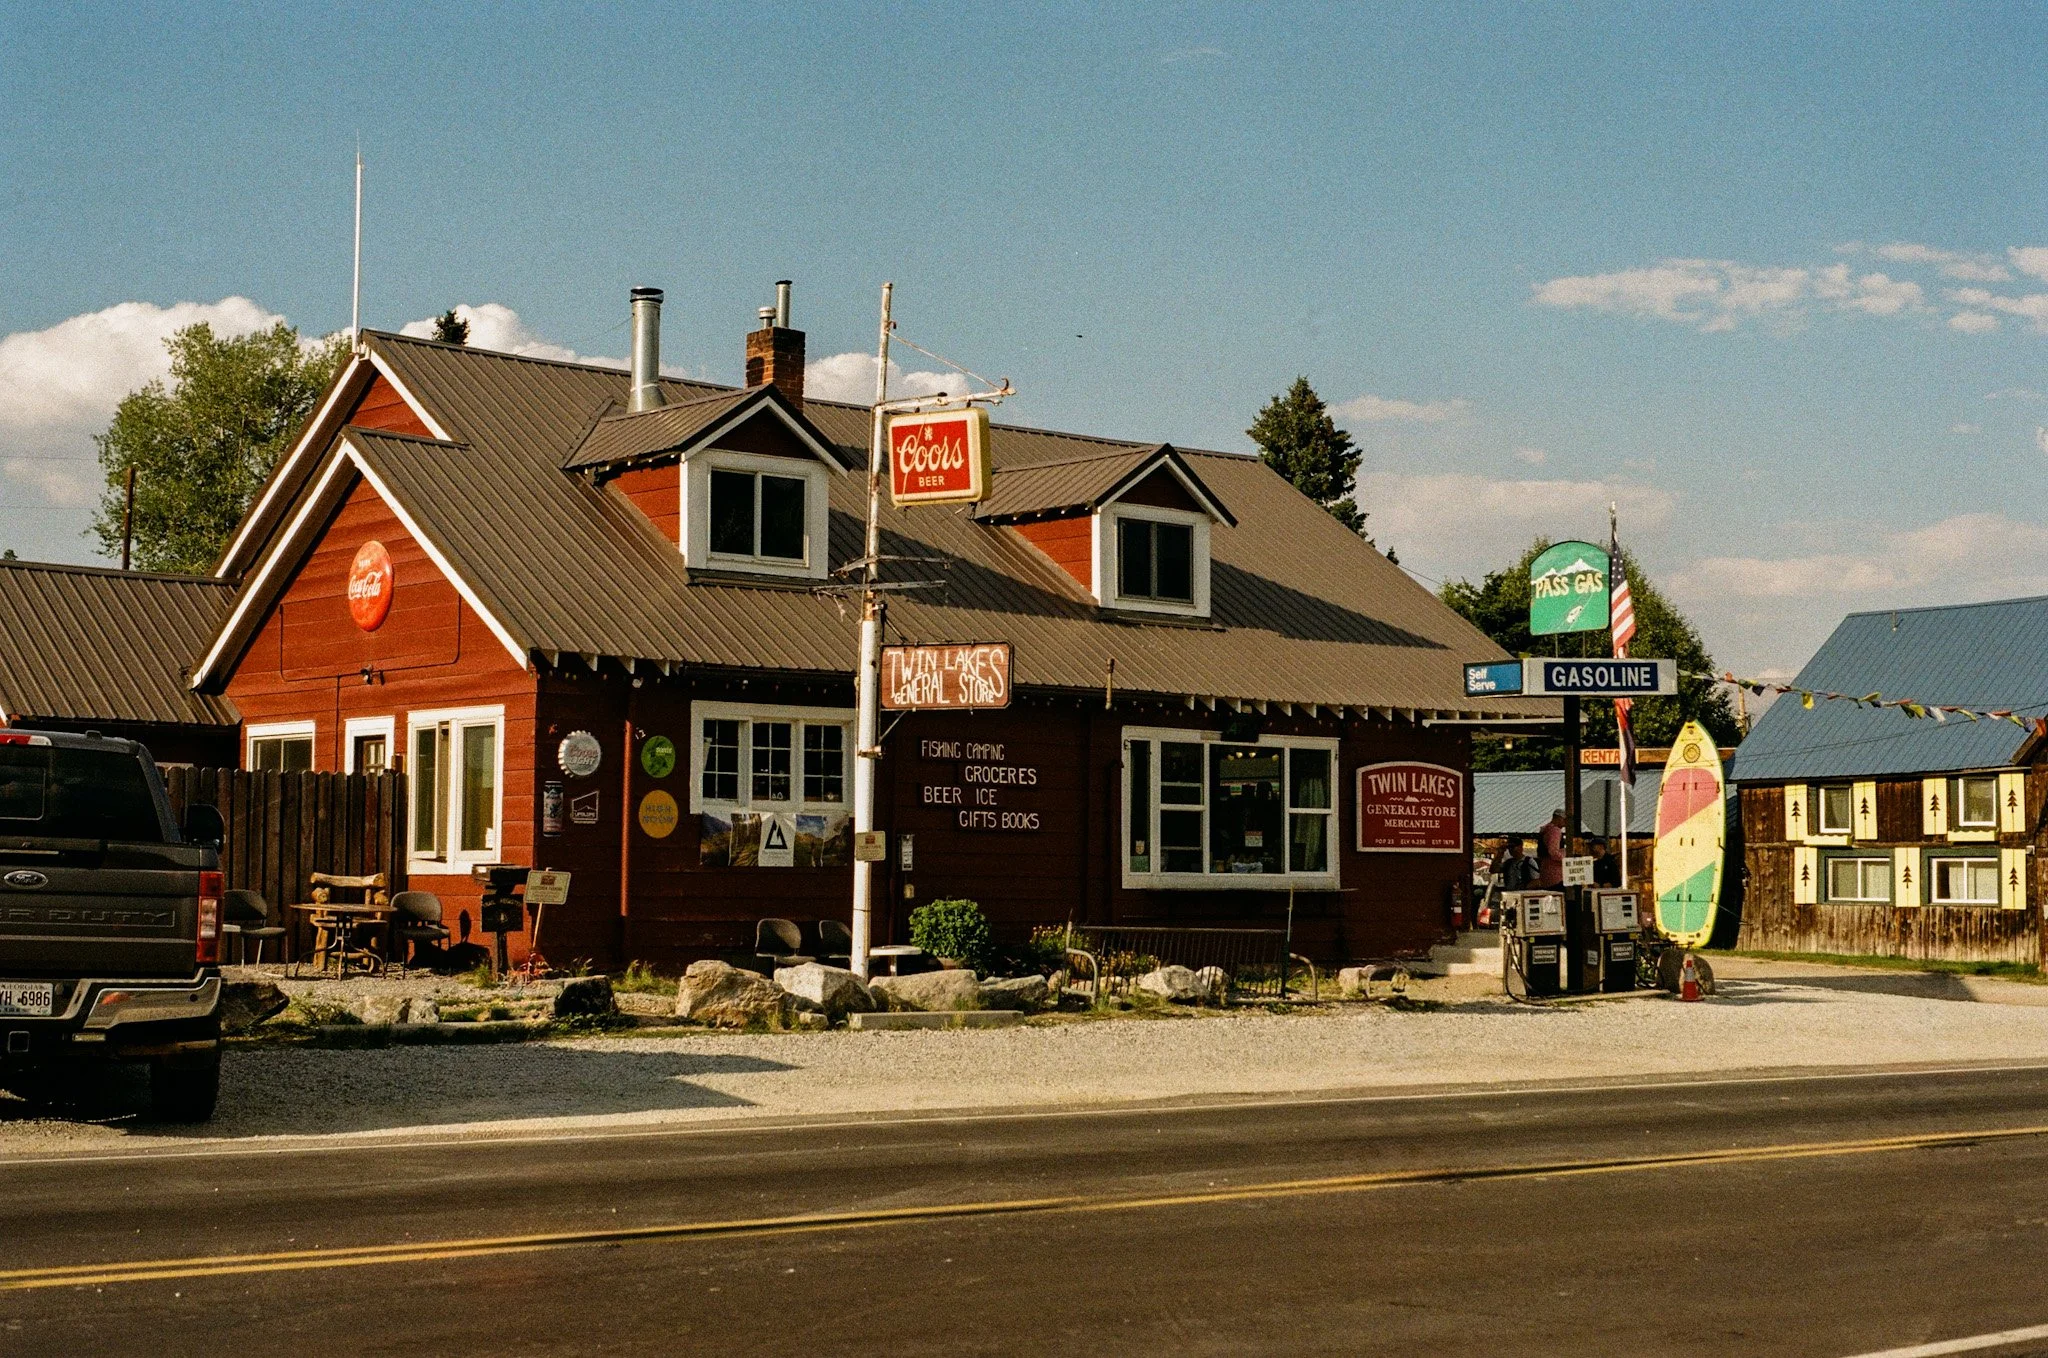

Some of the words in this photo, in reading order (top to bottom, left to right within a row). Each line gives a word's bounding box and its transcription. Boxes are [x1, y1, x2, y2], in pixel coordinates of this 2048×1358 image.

[896, 435, 965, 474] Coors
[918, 475, 946, 487] BEER
[1535, 576, 1570, 599] PASS
[1574, 572, 1604, 593] GAS
[887, 651, 937, 699] TWIN
[944, 648, 1005, 699] LAKES
[1468, 668, 1488, 680] Self
[1551, 666, 1652, 688] GASOLINE
[894, 671, 950, 705] GENERAL
[959, 671, 996, 704] STORE
[1468, 680, 1496, 691] Serve
[921, 739, 961, 760] FISHING
[966, 742, 1005, 761] CAMPING
[1583, 750, 1621, 764] RENTA
[964, 765, 1037, 785] GROCERES
[923, 785, 962, 804] BEER
[975, 787, 998, 806] ICE
[1368, 773, 1407, 795] TWIN
[1412, 773, 1455, 798] LAKES
[958, 810, 997, 828] GIFTS
[1001, 811, 1040, 830] BOOKS
[1367, 804, 1418, 815] GENERAL
[1421, 806, 1456, 817] STORE
[1384, 819, 1440, 828] MERCANTILE
[50, 910, 168, 923] DUTY
[21, 990, 50, 1006] 6986
